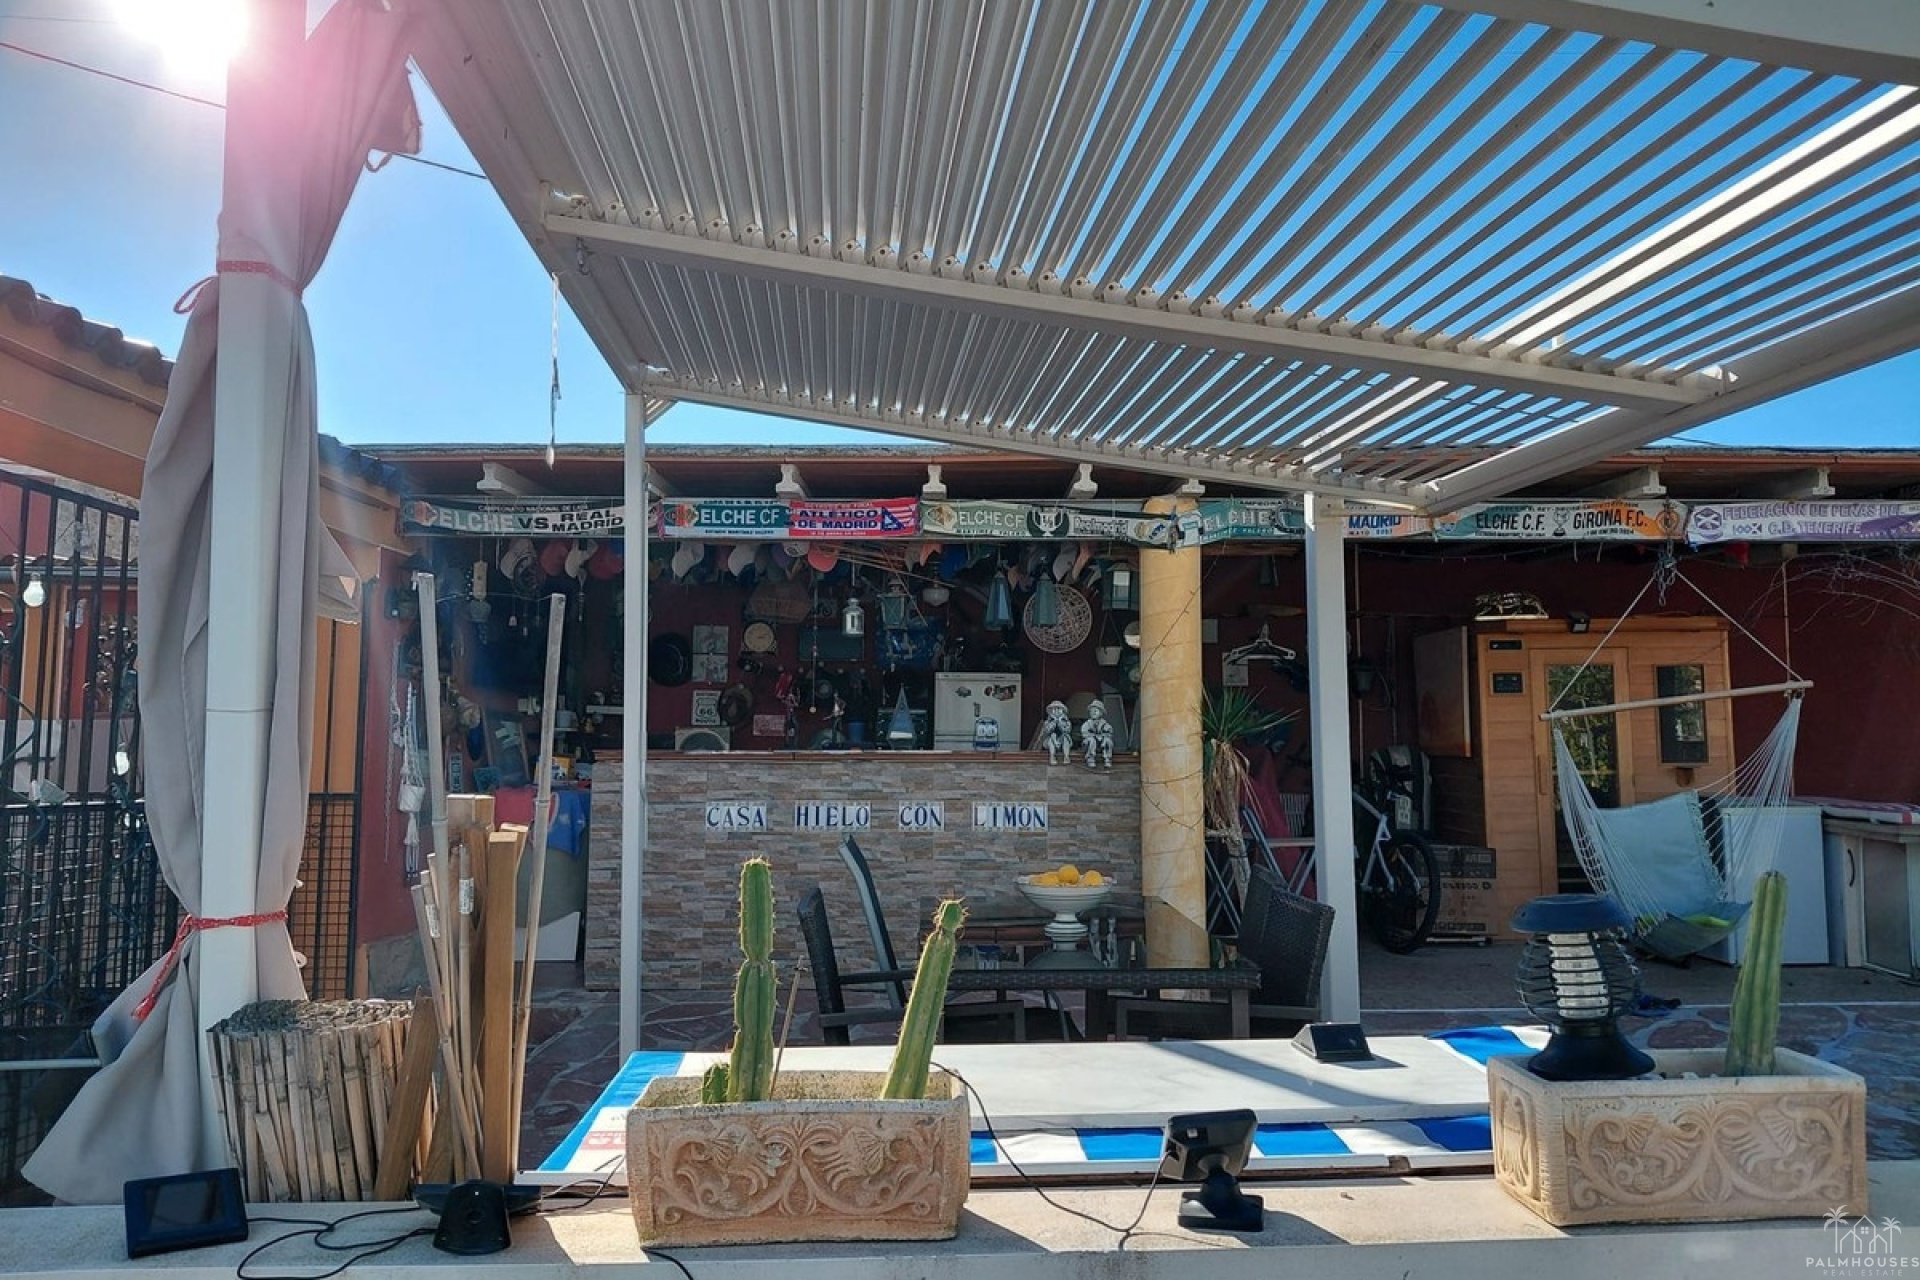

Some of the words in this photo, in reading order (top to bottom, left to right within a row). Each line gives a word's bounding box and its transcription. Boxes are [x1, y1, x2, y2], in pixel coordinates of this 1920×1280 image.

[561, 509, 618, 523] REAL
[700, 509, 756, 525] ELCHE
[760, 509, 780, 525] CF
[959, 510, 1003, 526] ELCHE
[1573, 508, 1622, 529] GIRONA
[1627, 509, 1647, 527] F.C.
[1809, 504, 1828, 517] DE
[439, 510, 513, 532] ELCHE
[518, 516, 549, 530] VS
[552, 516, 624, 532] MADRID
[798, 519, 816, 528] DE
[822, 519, 878, 528] MADRID
[1349, 514, 1401, 529] MADRID
[1476, 512, 1519, 530] ELCHE
[1523, 513, 1545, 530] C.F.
[1797, 520, 1861, 534] TENERIFE
[706, 805, 765, 827] CASA
[795, 805, 870, 827] HIELO
[899, 805, 943, 827] CON
[973, 805, 1047, 828] LIMON
